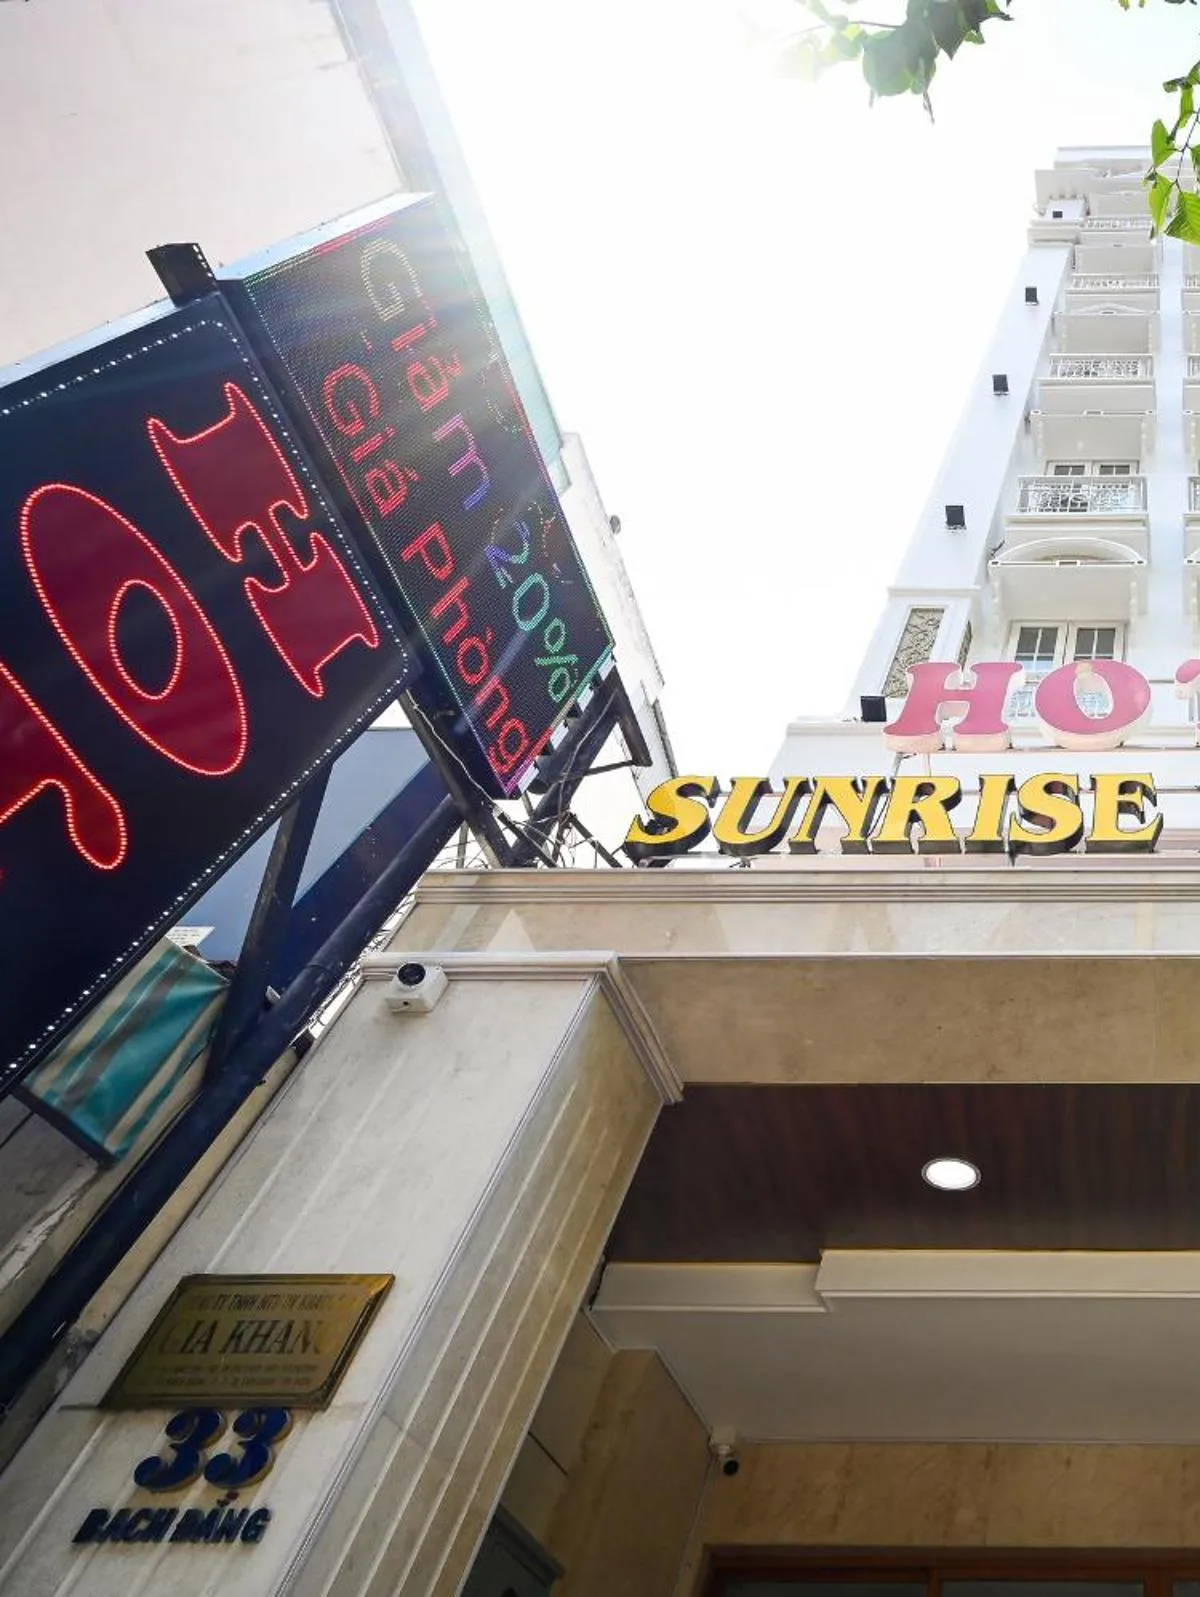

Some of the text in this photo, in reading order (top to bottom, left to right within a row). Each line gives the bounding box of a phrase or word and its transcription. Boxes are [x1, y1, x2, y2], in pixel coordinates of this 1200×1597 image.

[322, 362, 531, 774] Giá Phòng
[361, 237, 579, 703] Giảm 20%
[621, 772, 1164, 856] SUNRISE
[134, 1406, 293, 1491] 33
